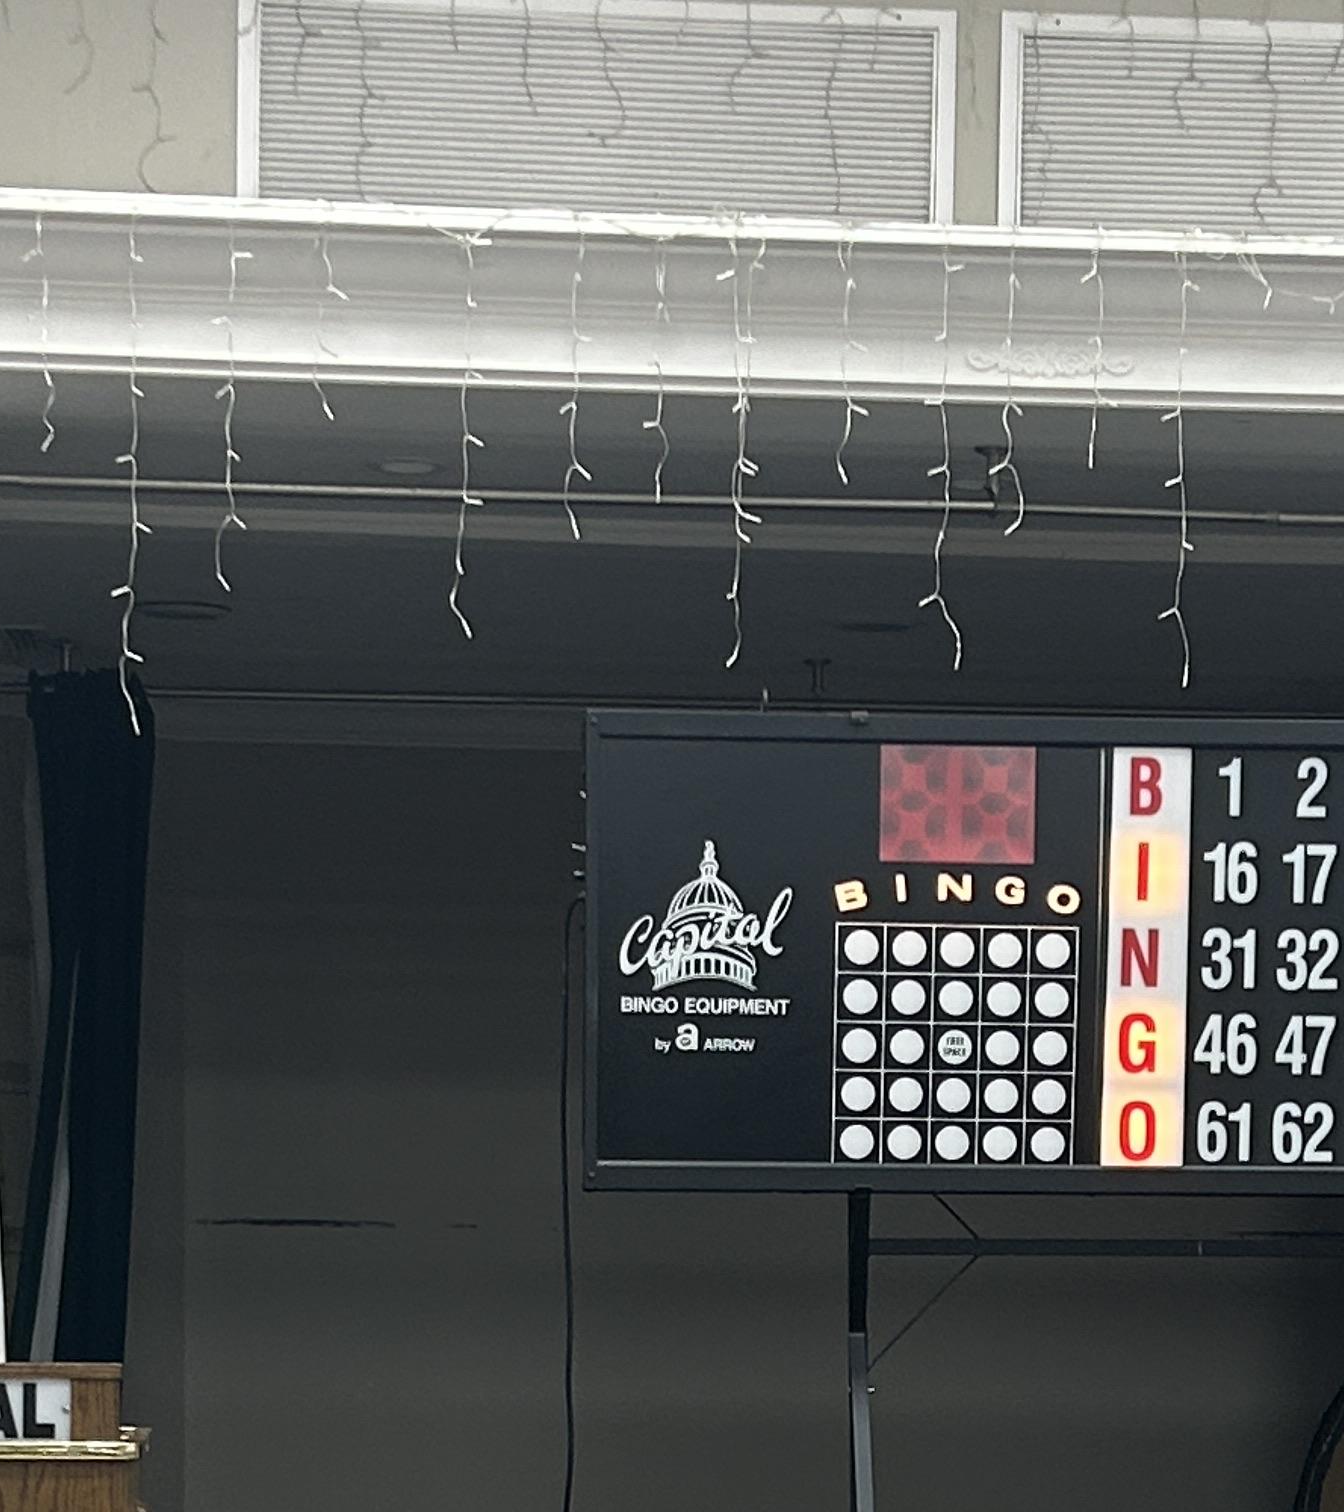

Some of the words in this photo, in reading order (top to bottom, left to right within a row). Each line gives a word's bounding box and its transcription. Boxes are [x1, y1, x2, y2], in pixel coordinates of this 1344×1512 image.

[1218, 757, 1242, 817] 1
[1296, 757, 1328, 818] 2
[1203, 841, 1258, 904] 16
[1282, 843, 1337, 904] 17
[619, 887, 793, 976] Capital
[1200, 927, 1256, 990] 31
[1276, 928, 1339, 991] 32
[620, 996, 679, 1014] BINGO
[684, 997, 791, 1016] EQUIPMENT
[654, 1037, 672, 1054] by
[703, 1038, 756, 1052] ARROW
[1193, 1013, 1257, 1076] 46
[1274, 1015, 1337, 1076] 47
[1197, 1100, 1251, 1163] 61
[1272, 1101, 1334, 1164] 62
